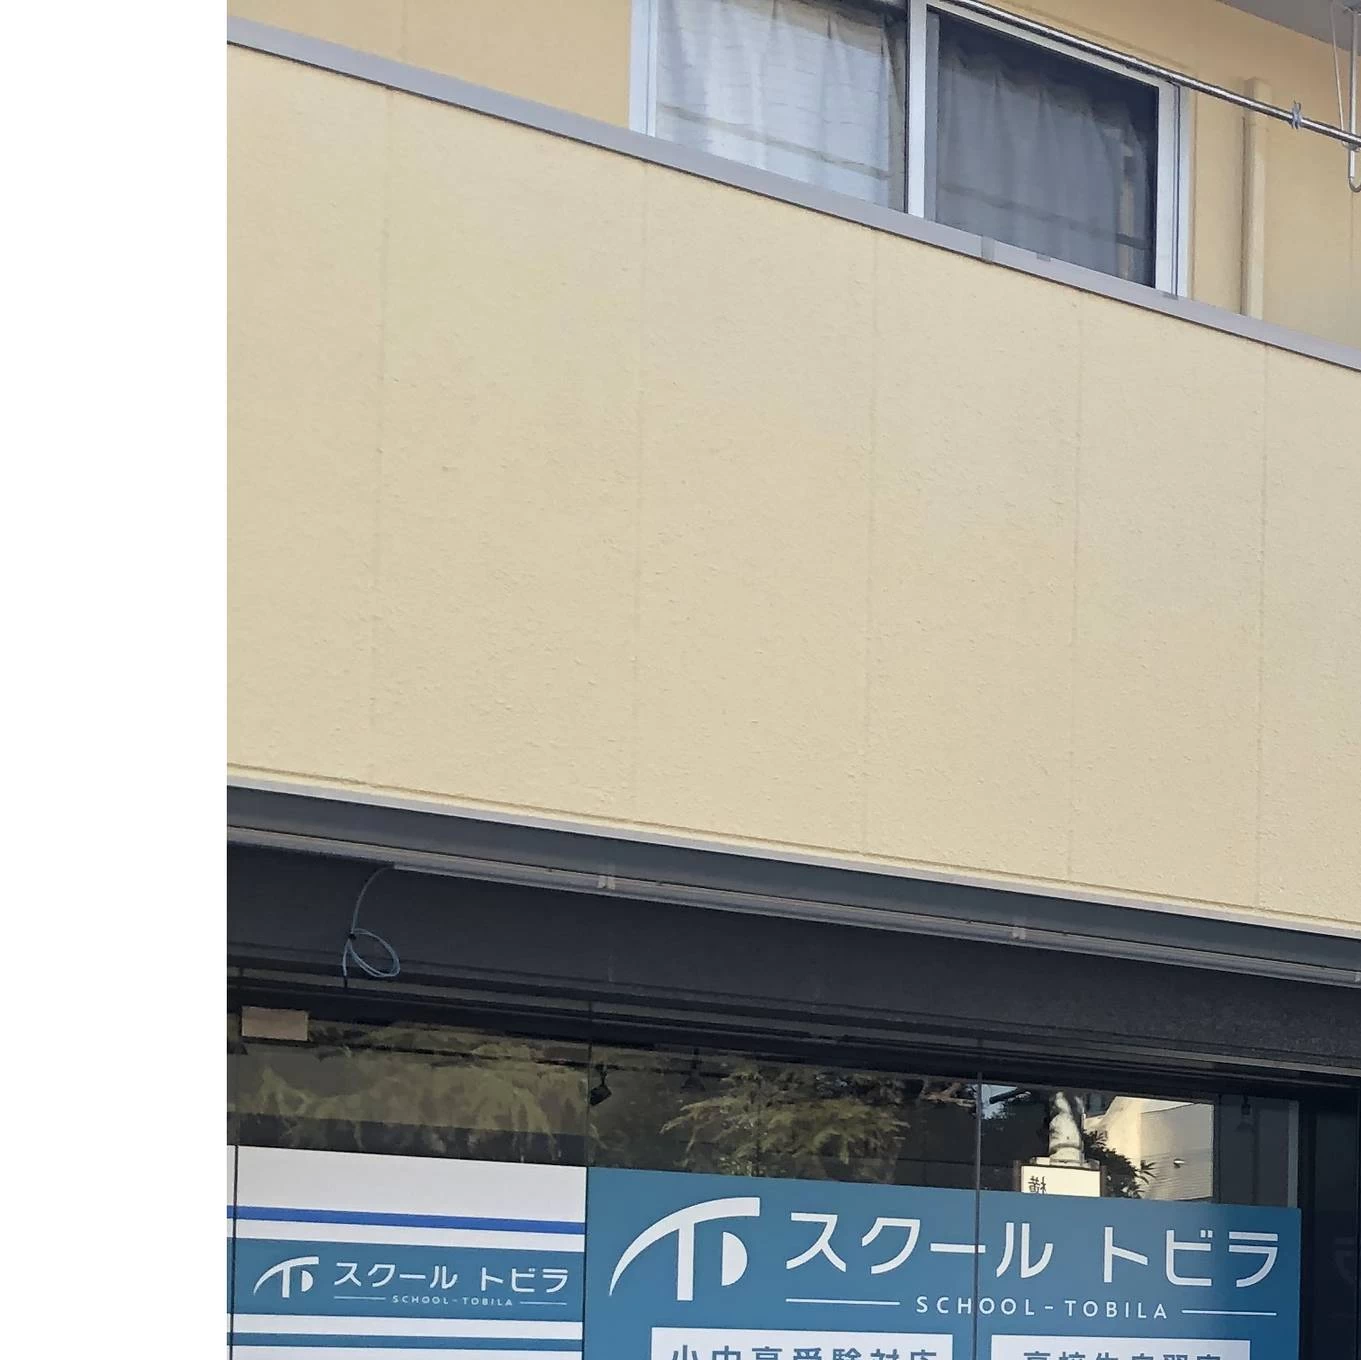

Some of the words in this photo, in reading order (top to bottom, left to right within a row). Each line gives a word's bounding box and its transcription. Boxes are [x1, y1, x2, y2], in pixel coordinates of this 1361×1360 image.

[785, 1211, 1054, 1279] スクール
[1103, 1225, 1279, 1288] トビラ
[333, 1261, 458, 1289] スクール
[480, 1266, 568, 1293] トビラ
[391, 1295, 514, 1307] SCHOOL-TOBILA
[915, 1295, 1169, 1321] SCHOOL-TOBILA
